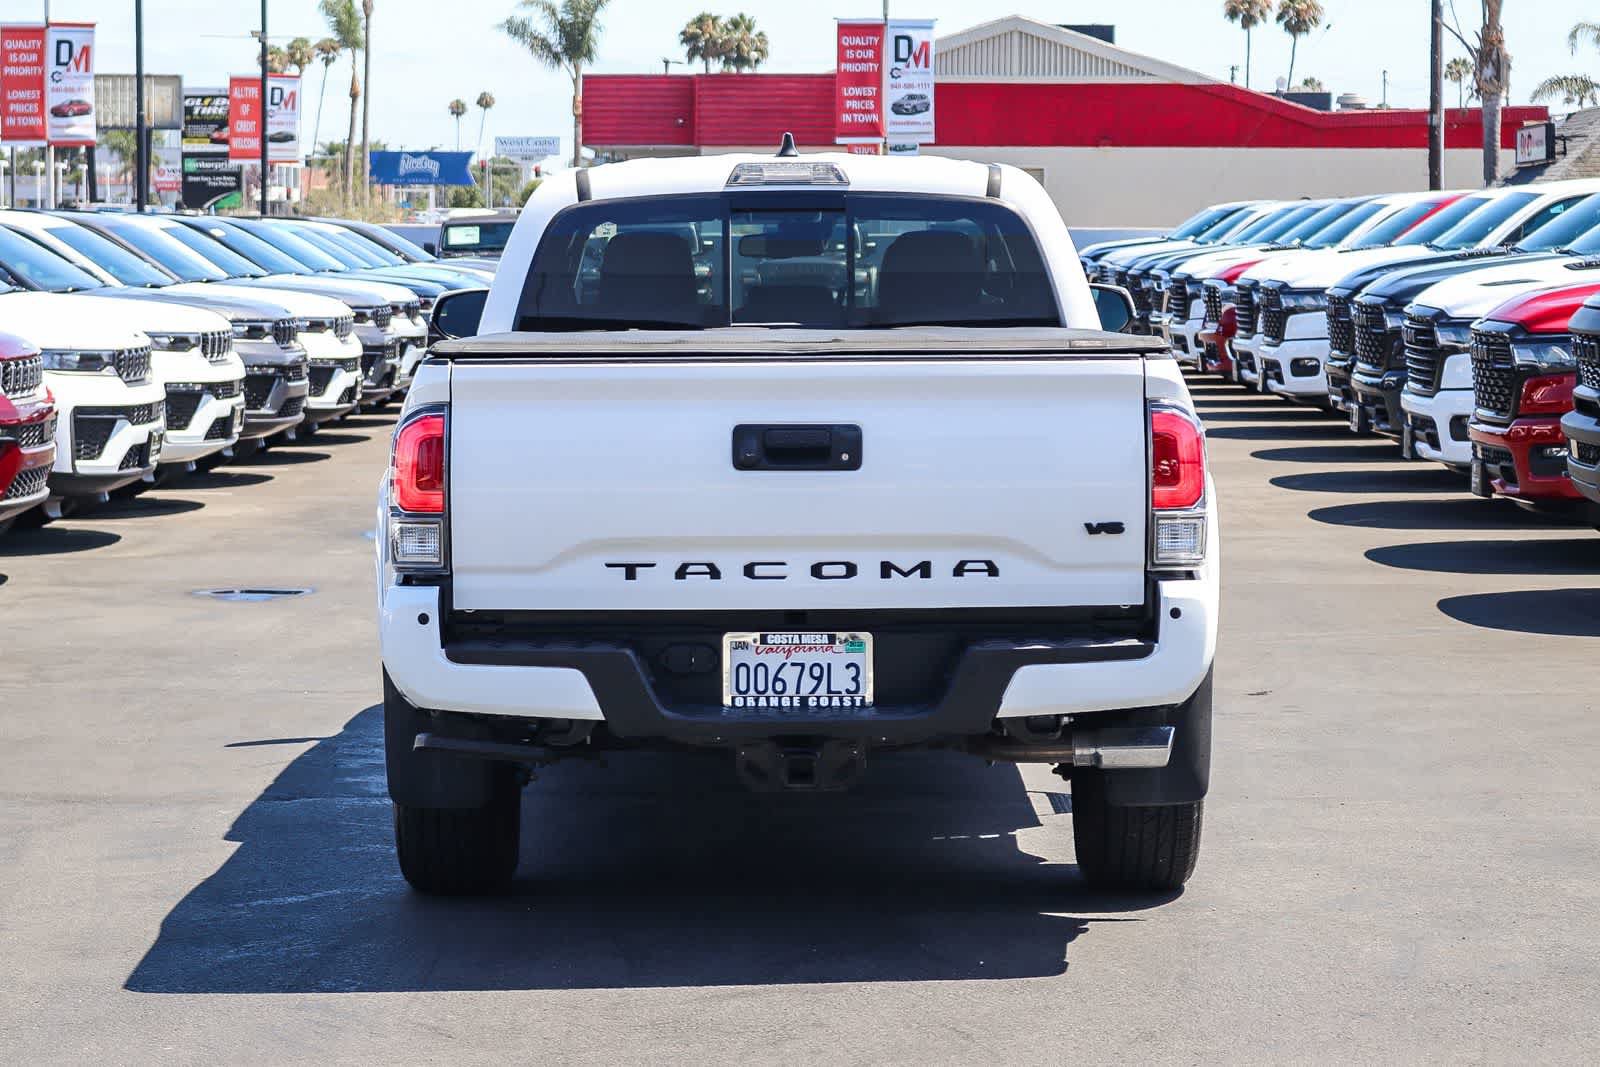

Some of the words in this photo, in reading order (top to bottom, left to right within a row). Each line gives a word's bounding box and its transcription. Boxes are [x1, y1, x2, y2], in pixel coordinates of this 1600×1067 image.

[5, 40, 42, 49] QUALITY
[842, 36, 879, 46] QUALITY
[9, 53, 18, 62] IS
[19, 53, 38, 62] OUR
[847, 50, 855, 58] IS
[856, 50, 874, 58] OUR
[4, 66, 43, 75] PRIORITY
[841, 63, 879, 73] PRIORITY
[7, 90, 41, 99] LOWEST
[843, 87, 877, 97] LOWEST
[9, 103, 39, 113] PRICES
[846, 100, 875, 109] PRICES
[6, 117, 15, 125] IN
[16, 117, 43, 125] TOWN
[842, 113, 852, 123] IN
[853, 113, 879, 123] TOWN
[1084, 522, 1125, 535] V6
[605, 560, 1000, 581] TACOMA
[766, 634, 799, 645] COSTA
[801, 634, 829, 645] MESA
[732, 641, 749, 650] JAN
[755, 645, 843, 660] California
[734, 662, 861, 695] 00679L3
[735, 697, 801, 707] ORANGE
[808, 697, 863, 707] COAST
